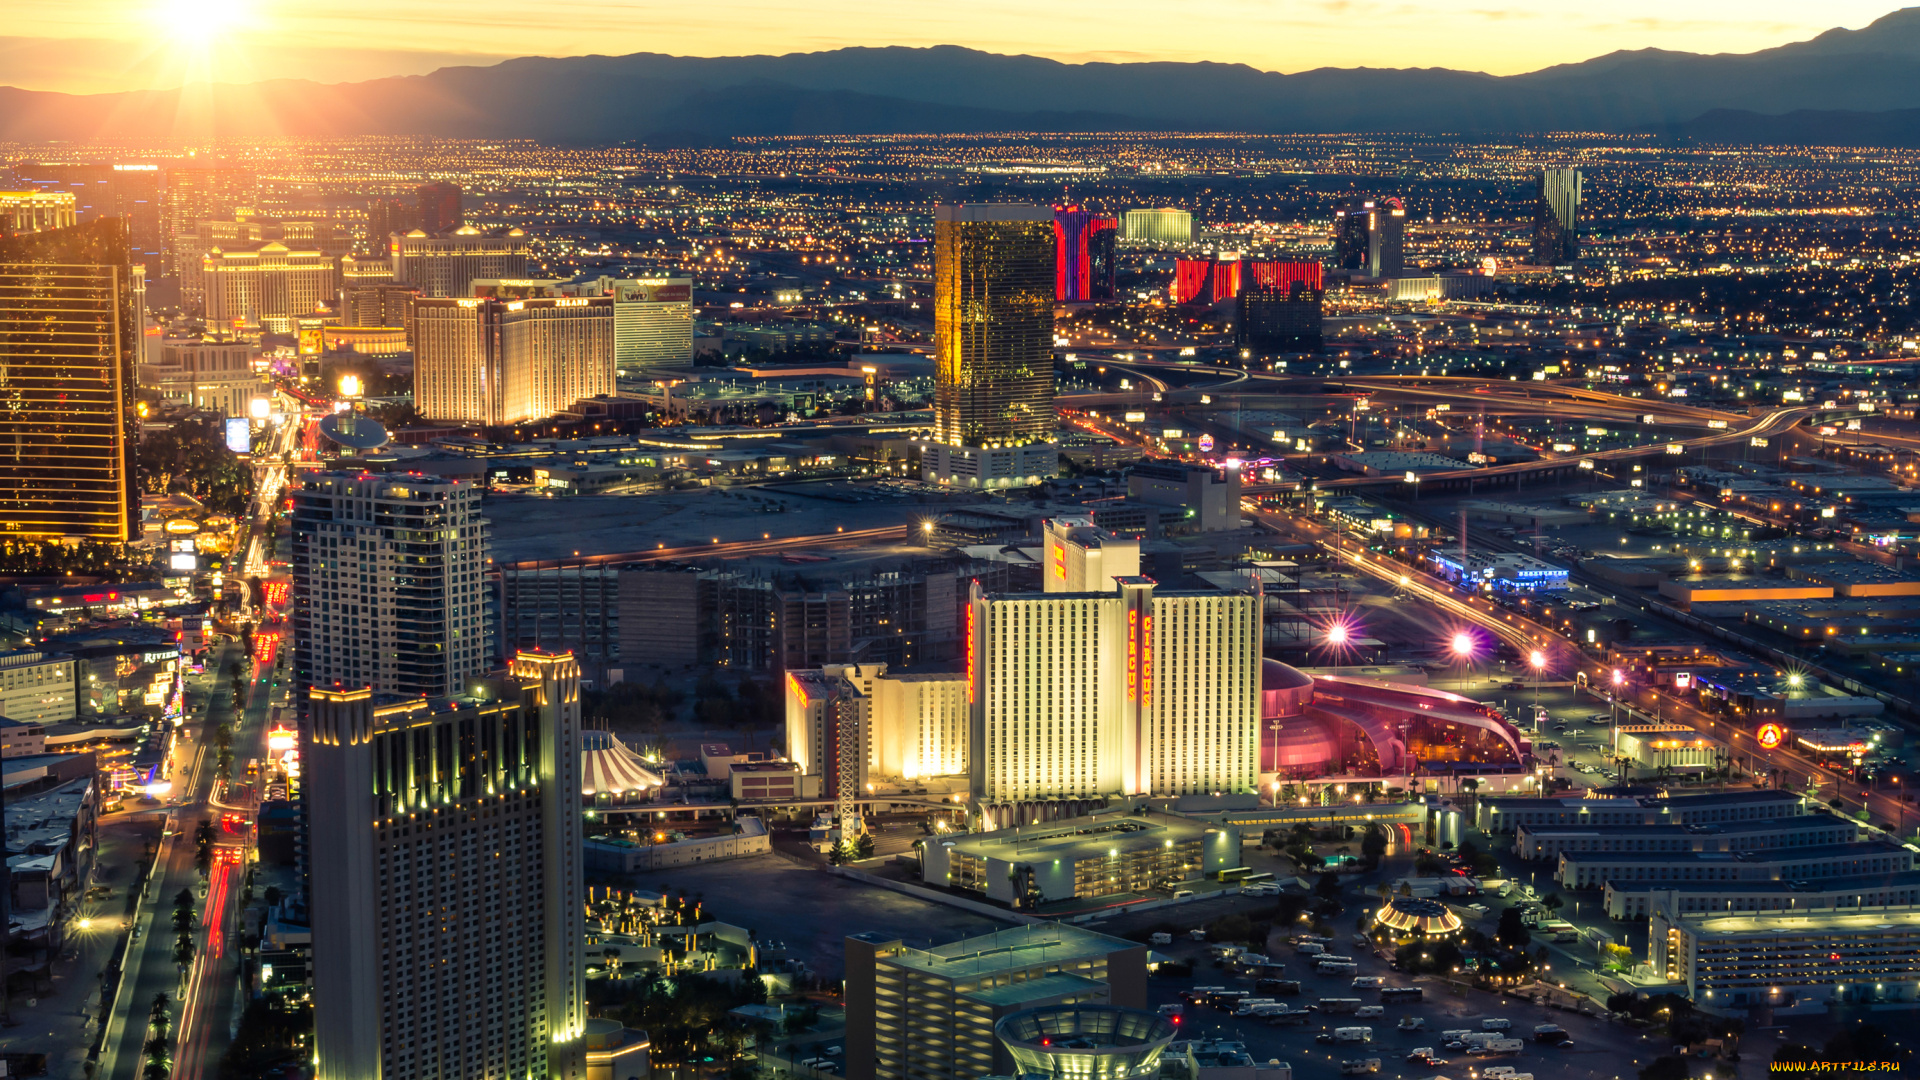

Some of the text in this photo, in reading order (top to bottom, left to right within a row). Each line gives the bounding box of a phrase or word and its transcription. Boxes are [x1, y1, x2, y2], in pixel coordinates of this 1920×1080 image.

[507, 279, 534, 287] MIRAGE
[643, 278, 668, 286] MIRAGE
[555, 299, 589, 307] ISLAND
[1142, 616, 1151, 708] CIRCUS
